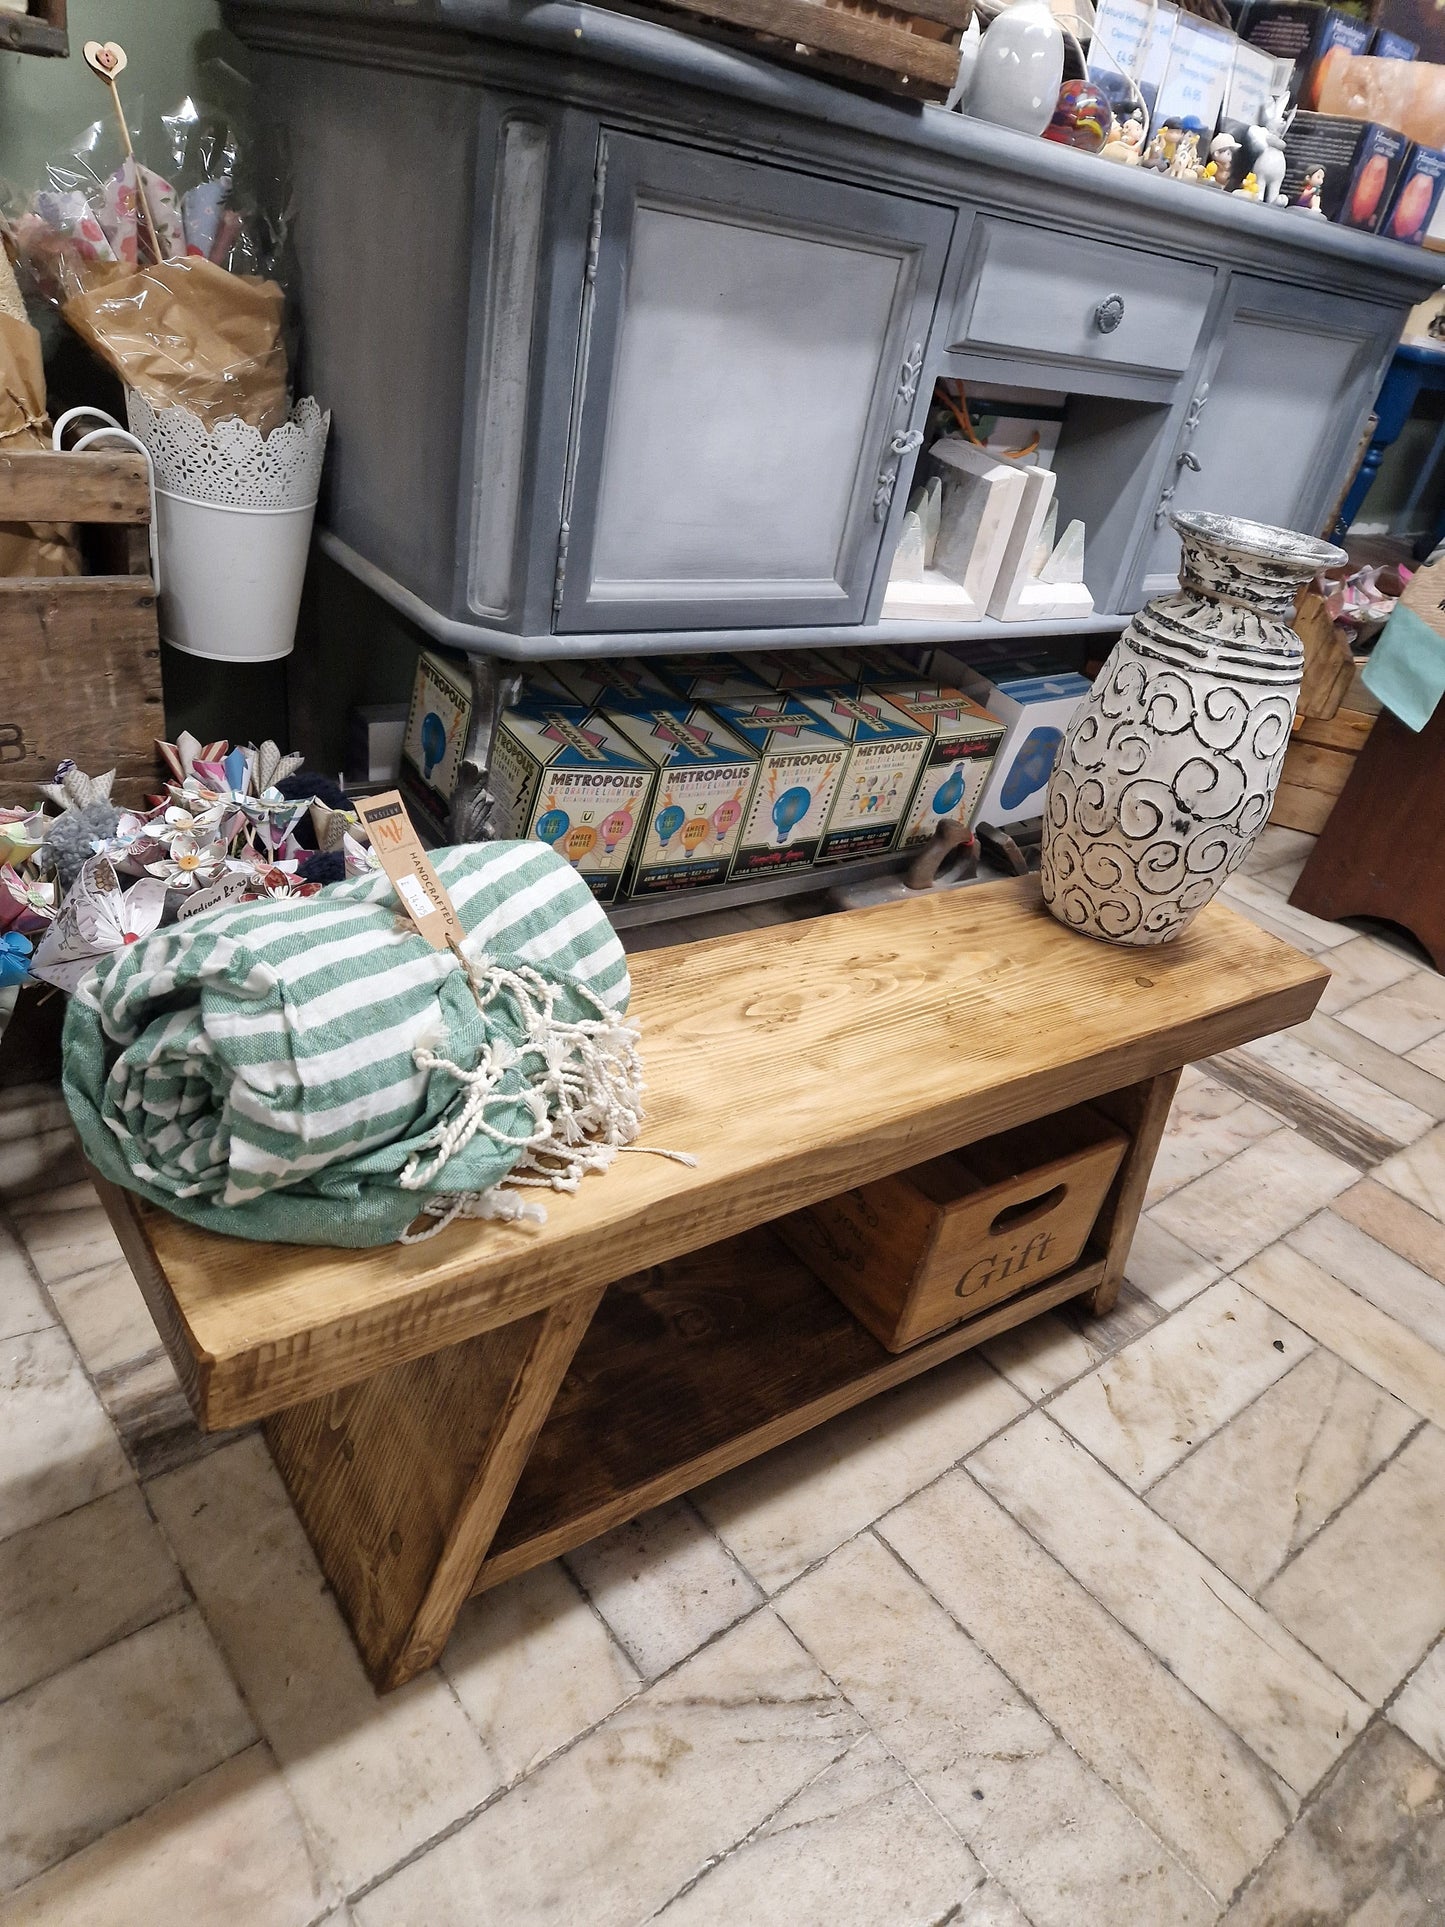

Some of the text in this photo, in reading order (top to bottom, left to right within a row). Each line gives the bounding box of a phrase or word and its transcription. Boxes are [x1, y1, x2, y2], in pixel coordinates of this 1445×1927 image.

[739, 714, 811, 726] METROPOLIS
[496, 730, 535, 777] TROPOLIS
[857, 741, 924, 757] METROPOLIS
[769, 752, 842, 769] METROPOLIS
[550, 773, 643, 789] METROPOLIS
[667, 767, 750, 784] METROPOLIS
[571, 833, 593, 841] AMBER
[409, 852, 454, 926] HANDCRAFTED
[183, 894, 222, 920] Medium
[955, 1232, 1056, 1298] Gift
